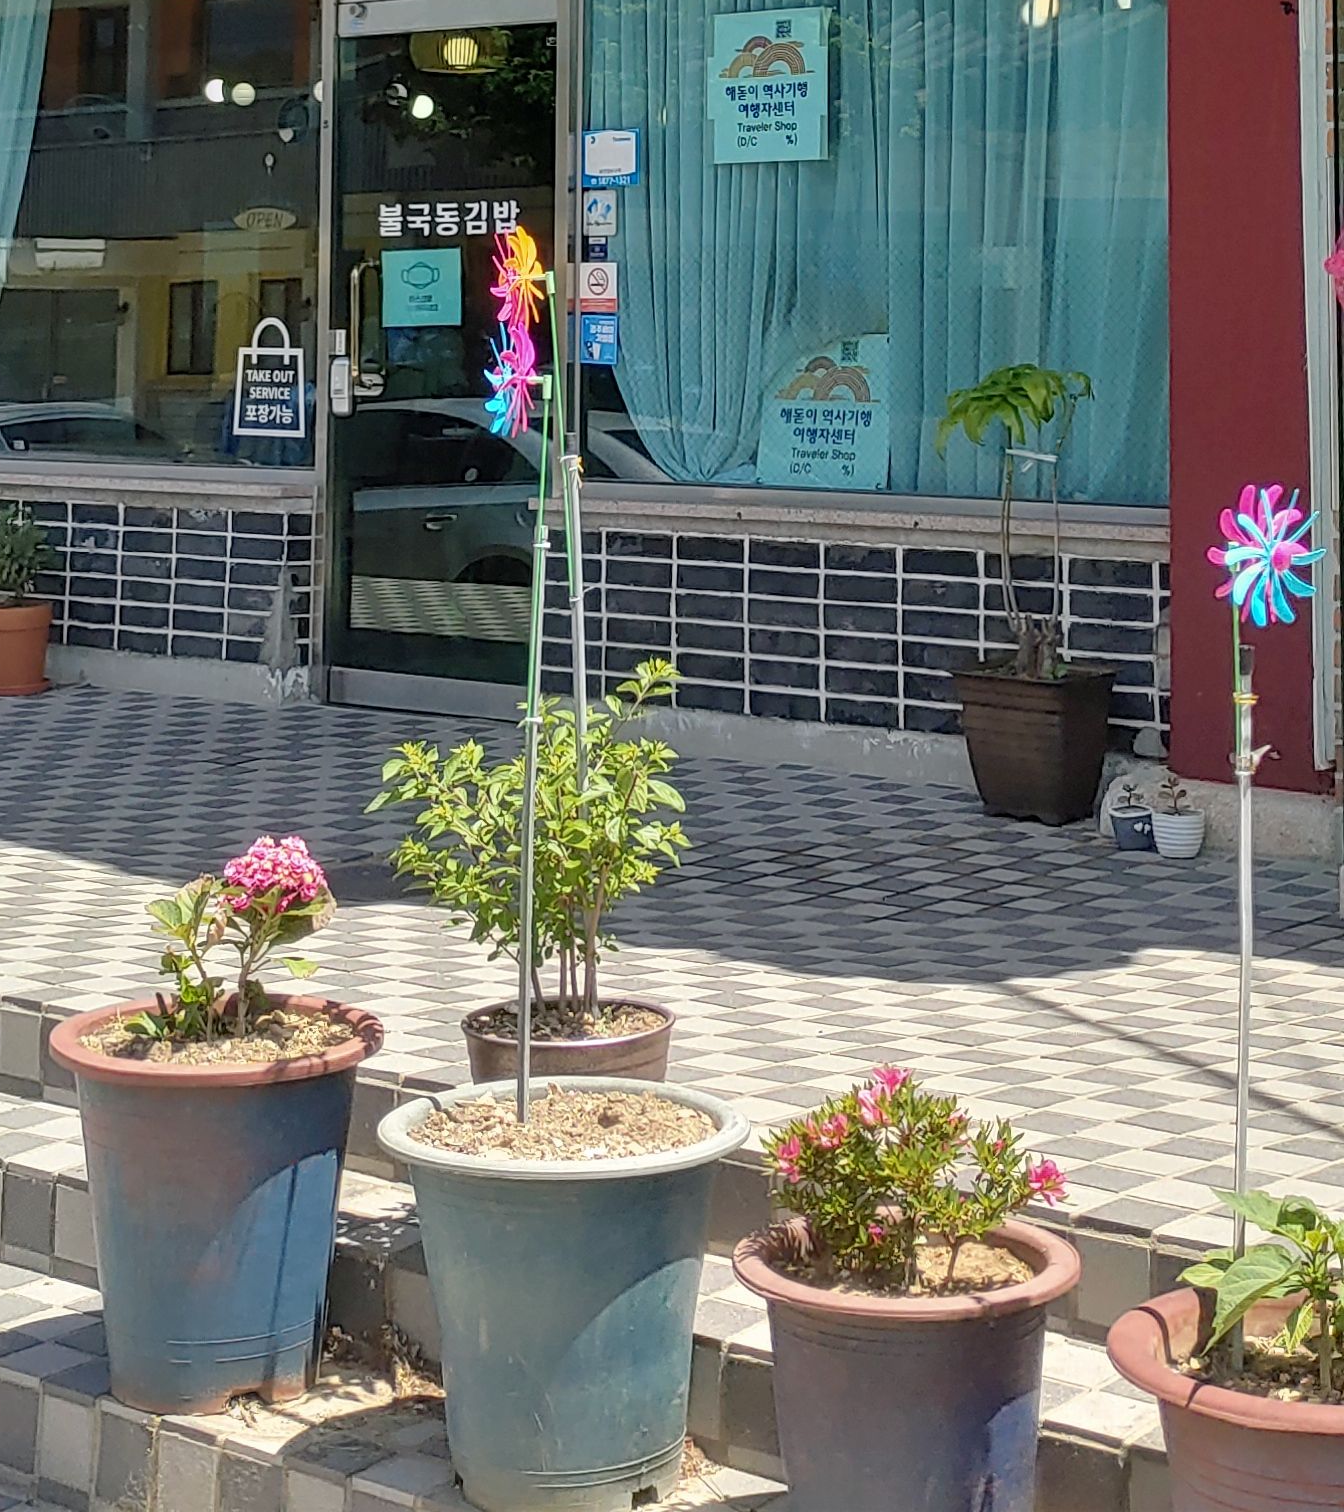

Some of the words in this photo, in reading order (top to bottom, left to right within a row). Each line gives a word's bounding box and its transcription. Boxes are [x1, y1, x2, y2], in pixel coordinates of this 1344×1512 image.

[762, 81, 809, 99] 역사기행
[737, 122, 772, 133] Traveler
[774, 120, 798, 132] Shop
[246, 211, 285, 229] OPEN
[378, 199, 521, 237] 불국동김밥
[244, 369, 272, 383] TAKE
[272, 369, 296, 384] OUT
[249, 386, 291, 400] SERVICE
[244, 403, 294, 425] 포장가능
[822, 409, 873, 428] 역사기행
[791, 447, 829, 460] Traveler
[831, 448, 856, 461] Shop
